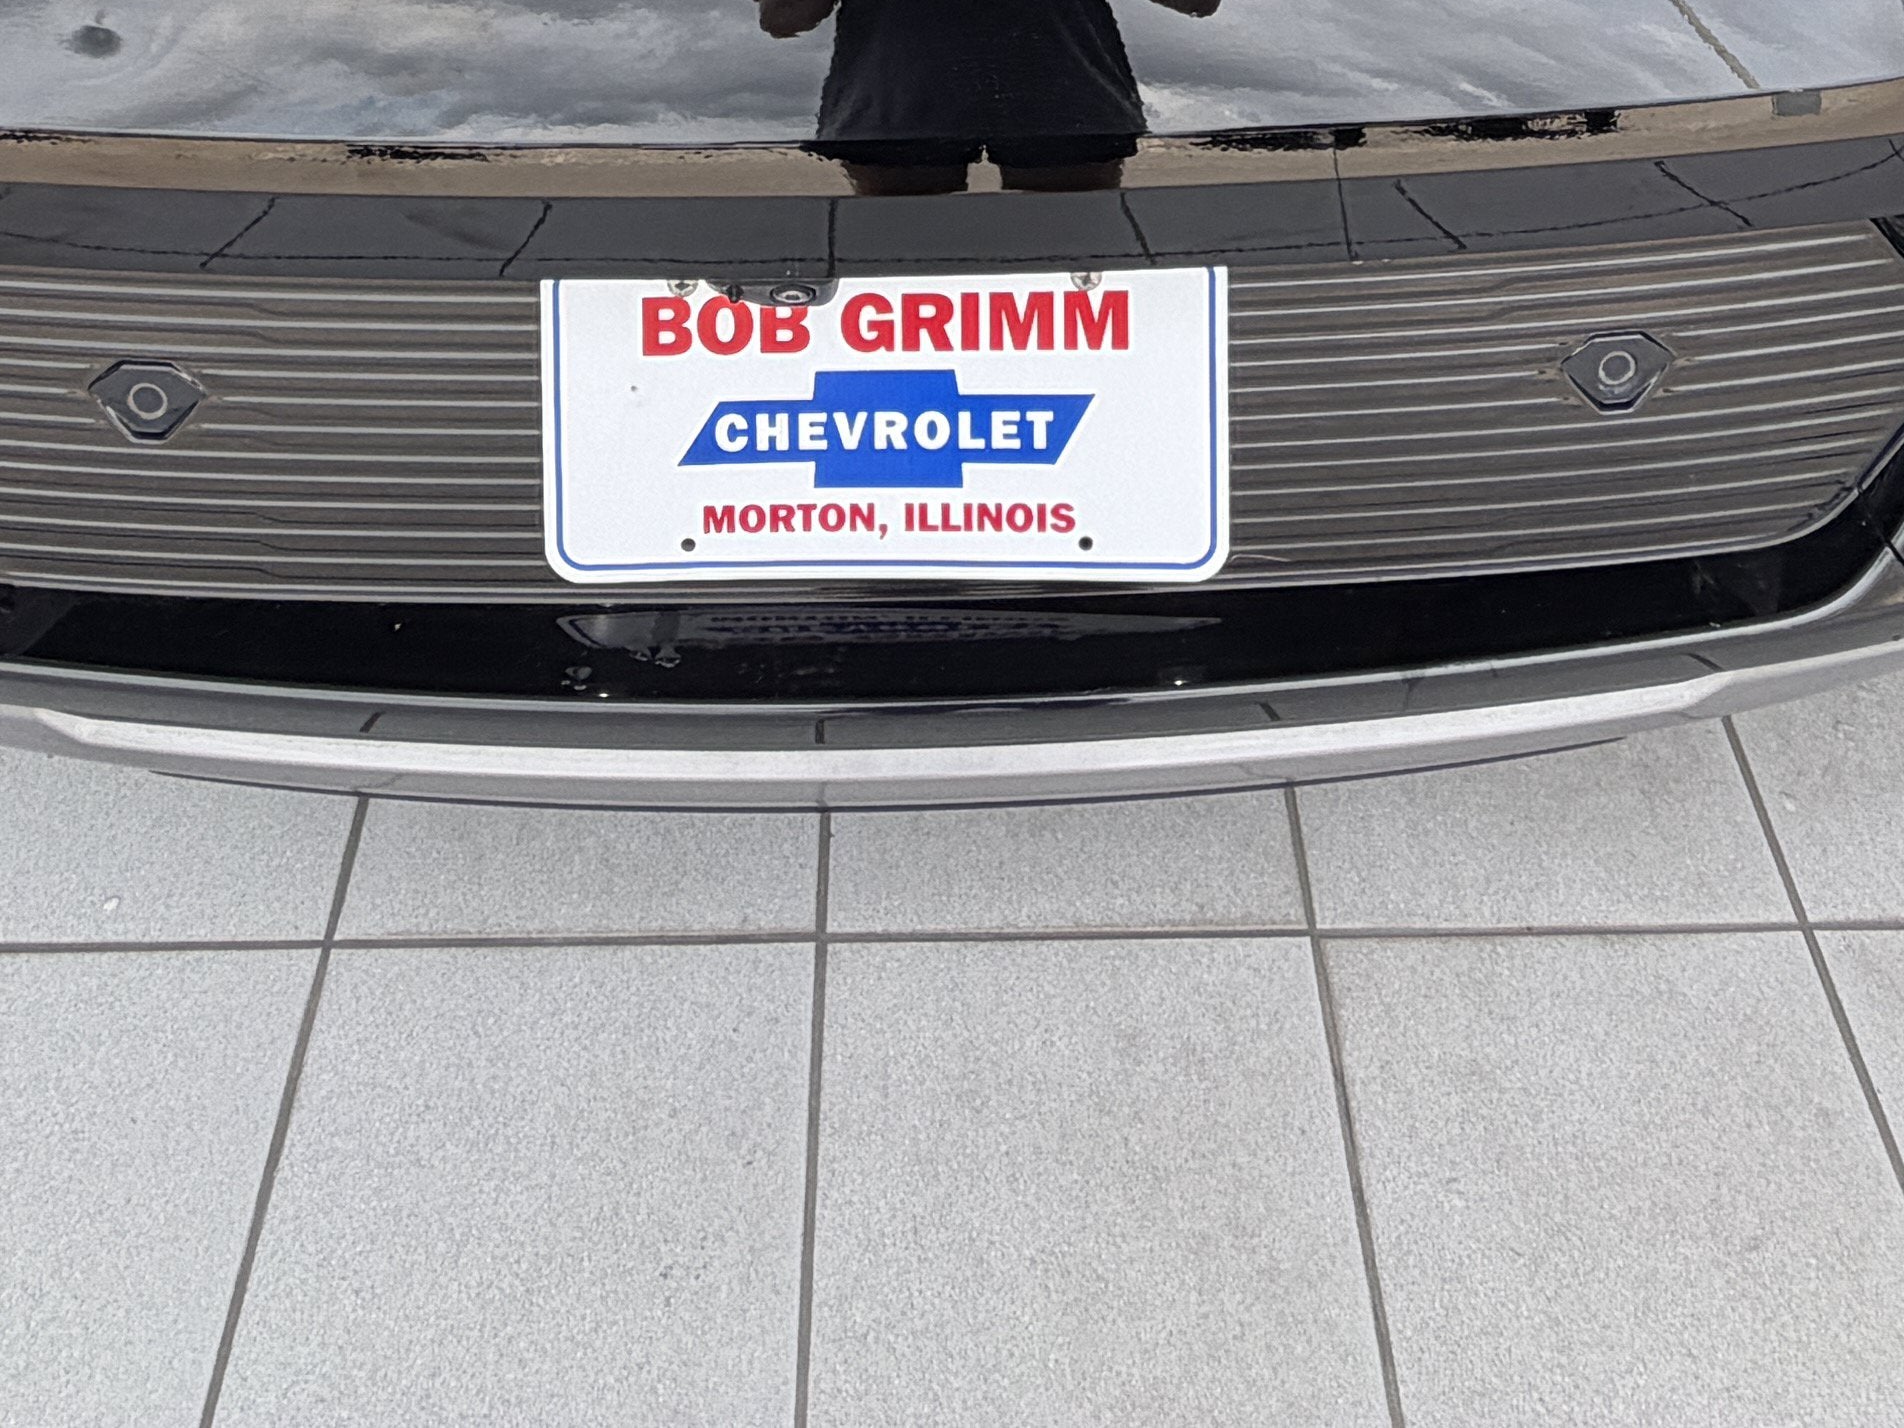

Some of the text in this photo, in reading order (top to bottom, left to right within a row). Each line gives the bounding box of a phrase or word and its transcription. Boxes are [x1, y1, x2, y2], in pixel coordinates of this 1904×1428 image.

[641, 289, 1130, 356] BOB GRIMM
[713, 409, 1057, 452] CHEVROLET
[702, 501, 1077, 539] MORTON, ILLINOIS
